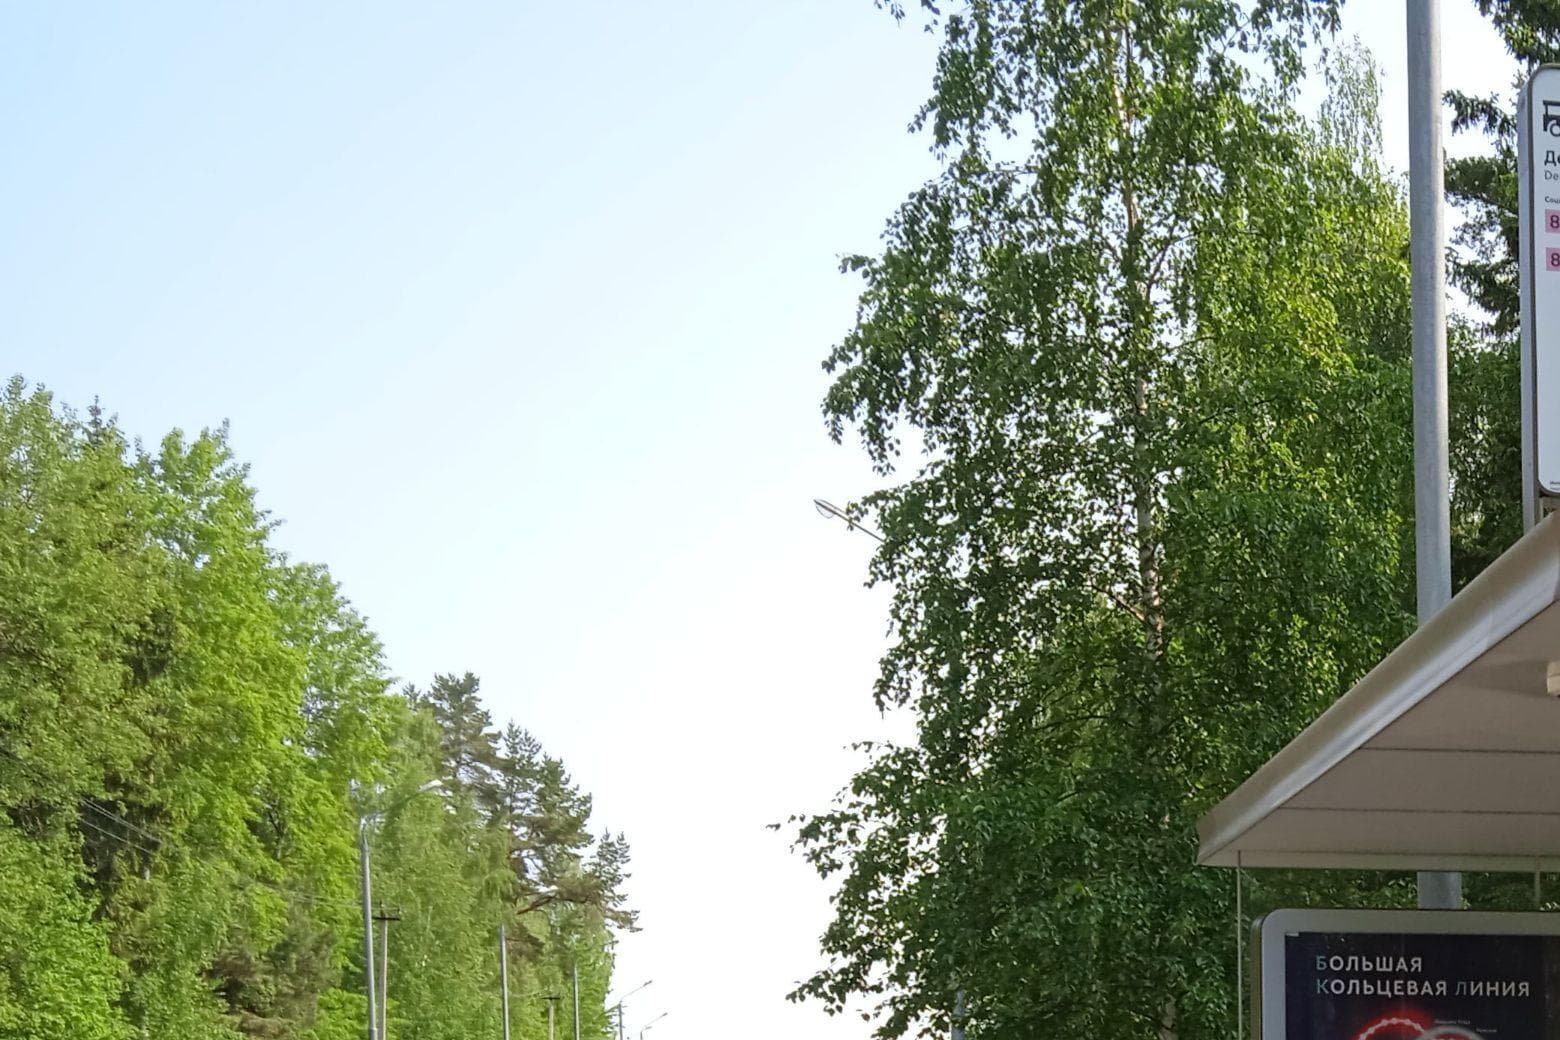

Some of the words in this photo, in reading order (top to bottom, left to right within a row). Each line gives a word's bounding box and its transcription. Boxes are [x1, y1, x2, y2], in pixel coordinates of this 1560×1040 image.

[1316, 955, 1422, 972] БОЛЬШАЯ
[1317, 979, 1447, 998] КОЛЬЦЕВАЯ
[1455, 981, 1530, 997] ЛИНИЯ
